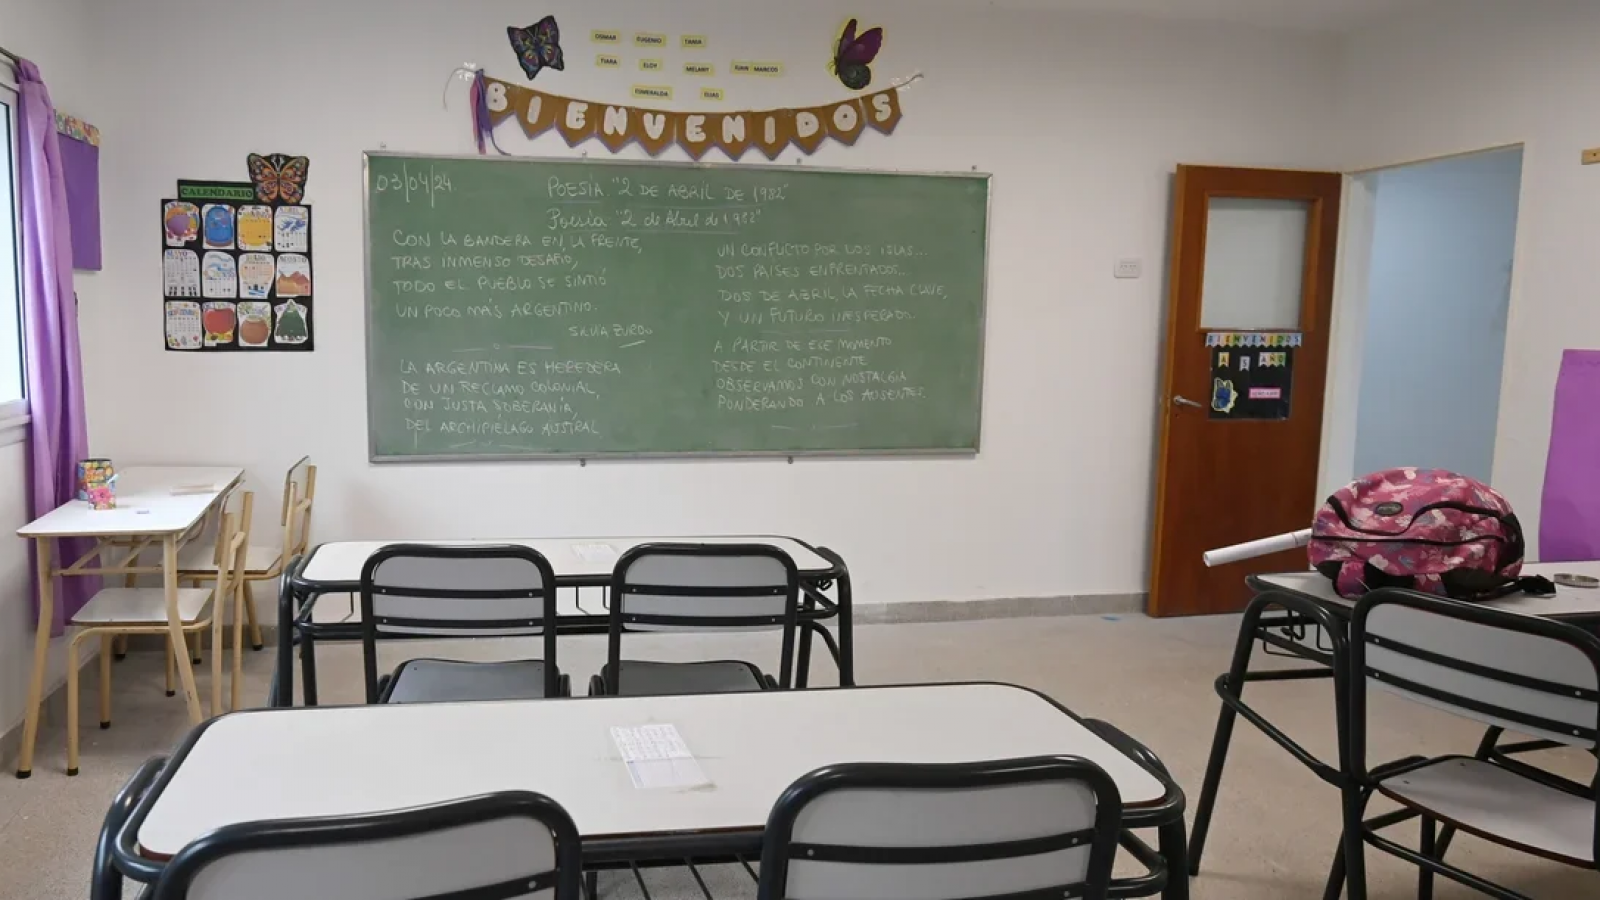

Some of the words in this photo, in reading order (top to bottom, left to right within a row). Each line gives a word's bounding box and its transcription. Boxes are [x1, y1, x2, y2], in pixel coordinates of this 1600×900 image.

[636, 36, 662, 45] EUGENIO
[600, 58, 618, 66] TIARA
[643, 61, 658, 69] ELOY
[753, 65, 779, 74] MARCOS
[634, 88, 669, 98] ESMERALDA
[485, 82, 893, 145] BIENVENIDOS
[182, 187, 253, 198] CALENDARIO
[640, 183, 659, 198] DE
[668, 181, 716, 200] ABRIL
[723, 186, 745, 201] DE
[644, 211, 660, 227] de
[665, 209, 699, 227] Abril
[705, 212, 719, 227] de
[393, 229, 431, 247] CON
[440, 232, 458, 246] LA
[463, 233, 532, 247] BANDERA
[571, 237, 585, 249] LA
[591, 236, 643, 254] FRENTE,
[717, 242, 735, 258] UN
[740, 242, 811, 258] CONFLICTO
[814, 242, 838, 257] POR
[391, 255, 431, 270] TRAS
[442, 255, 511, 269] INMENSO
[715, 264, 745, 279] DOS
[392, 279, 436, 295] TODO
[444, 278, 468, 291] EL
[477, 275, 532, 291] PUEBLO
[537, 276, 555, 289] SE
[565, 267, 607, 289] SINTIÓ
[717, 289, 752, 303] DOS
[759, 290, 781, 302] DE
[842, 286, 858, 300] LA
[863, 283, 904, 297] FECHA
[909, 283, 948, 300] CLAVE,
[395, 304, 418, 319] UN
[424, 305, 462, 319] POCO
[467, 298, 503, 319] MÁS
[510, 301, 599, 318] ARGENTINO.
[717, 310, 731, 328] Y
[739, 311, 763, 325] UN
[769, 306, 825, 324] FUTURO
[613, 323, 653, 337] ZURDO
[713, 339, 723, 353] A
[731, 336, 780, 353] PARTIR
[785, 338, 802, 351] DE
[808, 339, 834, 351] ESE
[838, 336, 892, 351] MOMENTO
[1207, 334, 1300, 344] BIENVENIDOS
[712, 359, 756, 374] DESDE
[762, 359, 780, 373] EL
[787, 355, 869, 370] CONTINENTE
[1261, 353, 1284, 363] AÑO
[400, 359, 417, 375] LA
[426, 360, 511, 375] ARGENTINA
[517, 360, 537, 374] ES
[545, 360, 621, 375] HEREDERA
[401, 380, 420, 395] DE
[429, 382, 454, 395] UN
[458, 379, 524, 397] RECLAMO
[531, 380, 600, 400] COLONIAL,
[716, 376, 804, 393] OBSERVAMOS
[810, 372, 837, 387] CON
[841, 370, 907, 387] NOSTALGIA
[404, 398, 434, 411] CON
[442, 398, 488, 413] JUSTA
[717, 394, 804, 412] PONDERANDO
[815, 392, 826, 407] A
[833, 388, 855, 403] LOS
[405, 417, 431, 432] DEL
